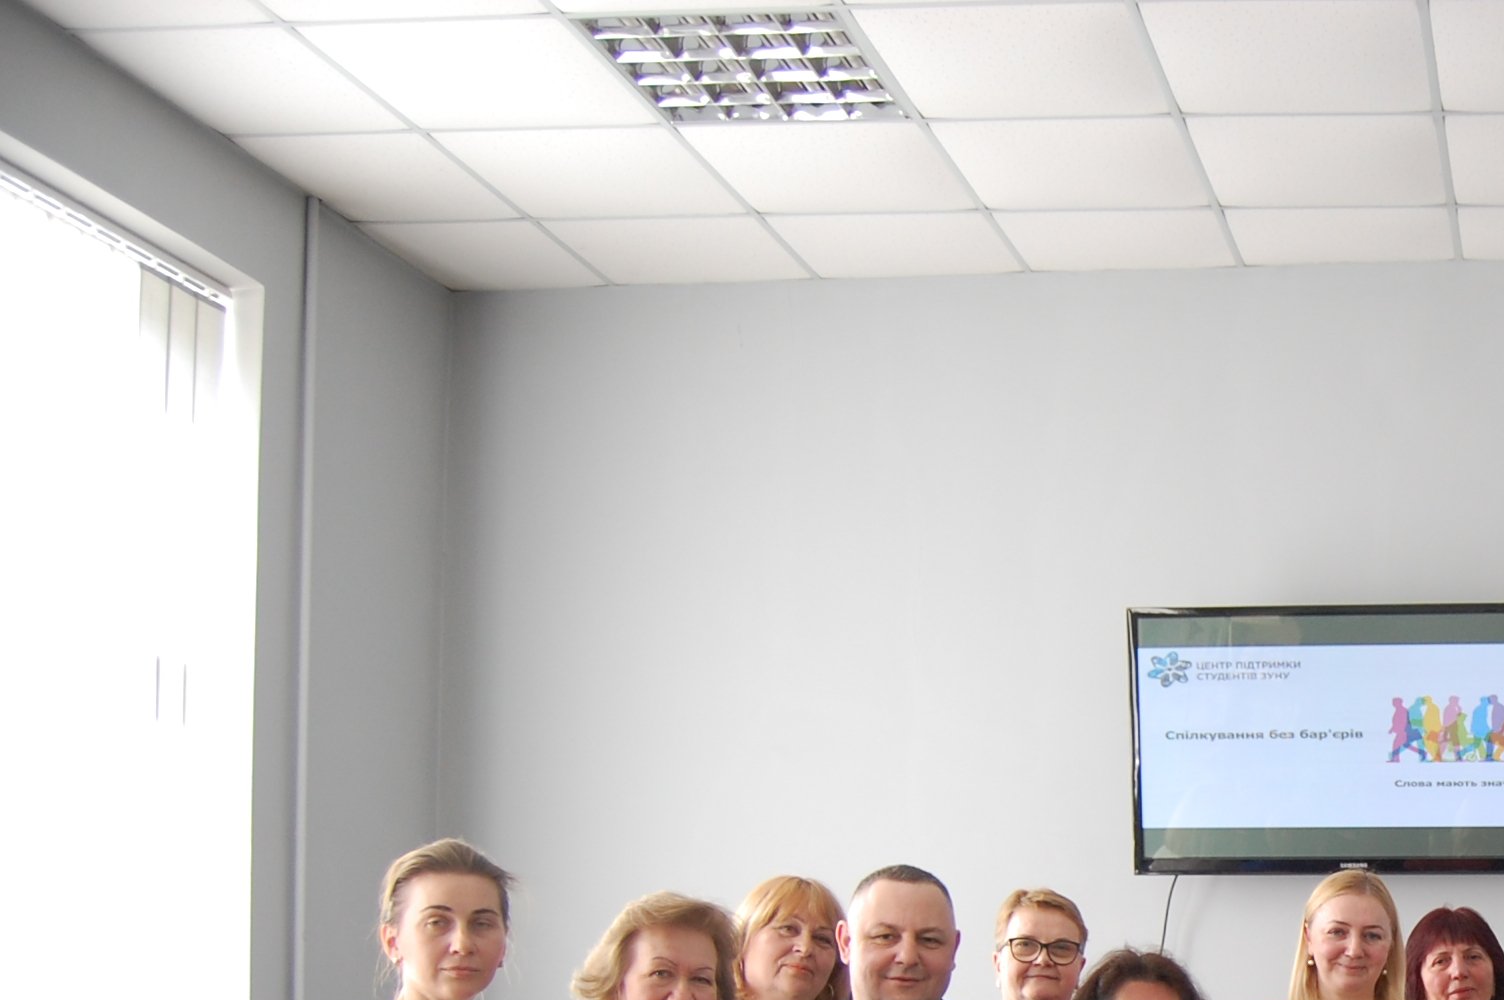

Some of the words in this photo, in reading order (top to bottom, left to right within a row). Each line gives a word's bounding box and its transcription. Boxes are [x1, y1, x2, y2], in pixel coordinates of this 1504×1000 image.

[1196, 661, 1232, 670] ЦЕНТР
[1235, 660, 1301, 670] ПІДТРИМКИ
[1196, 672, 1258, 681] СТУДЕНТІВ
[1165, 730, 1264, 742] Спілкування
[1269, 729, 1295, 739] без
[1394, 779, 1433, 788] Слова
[1436, 779, 1478, 788] мають
